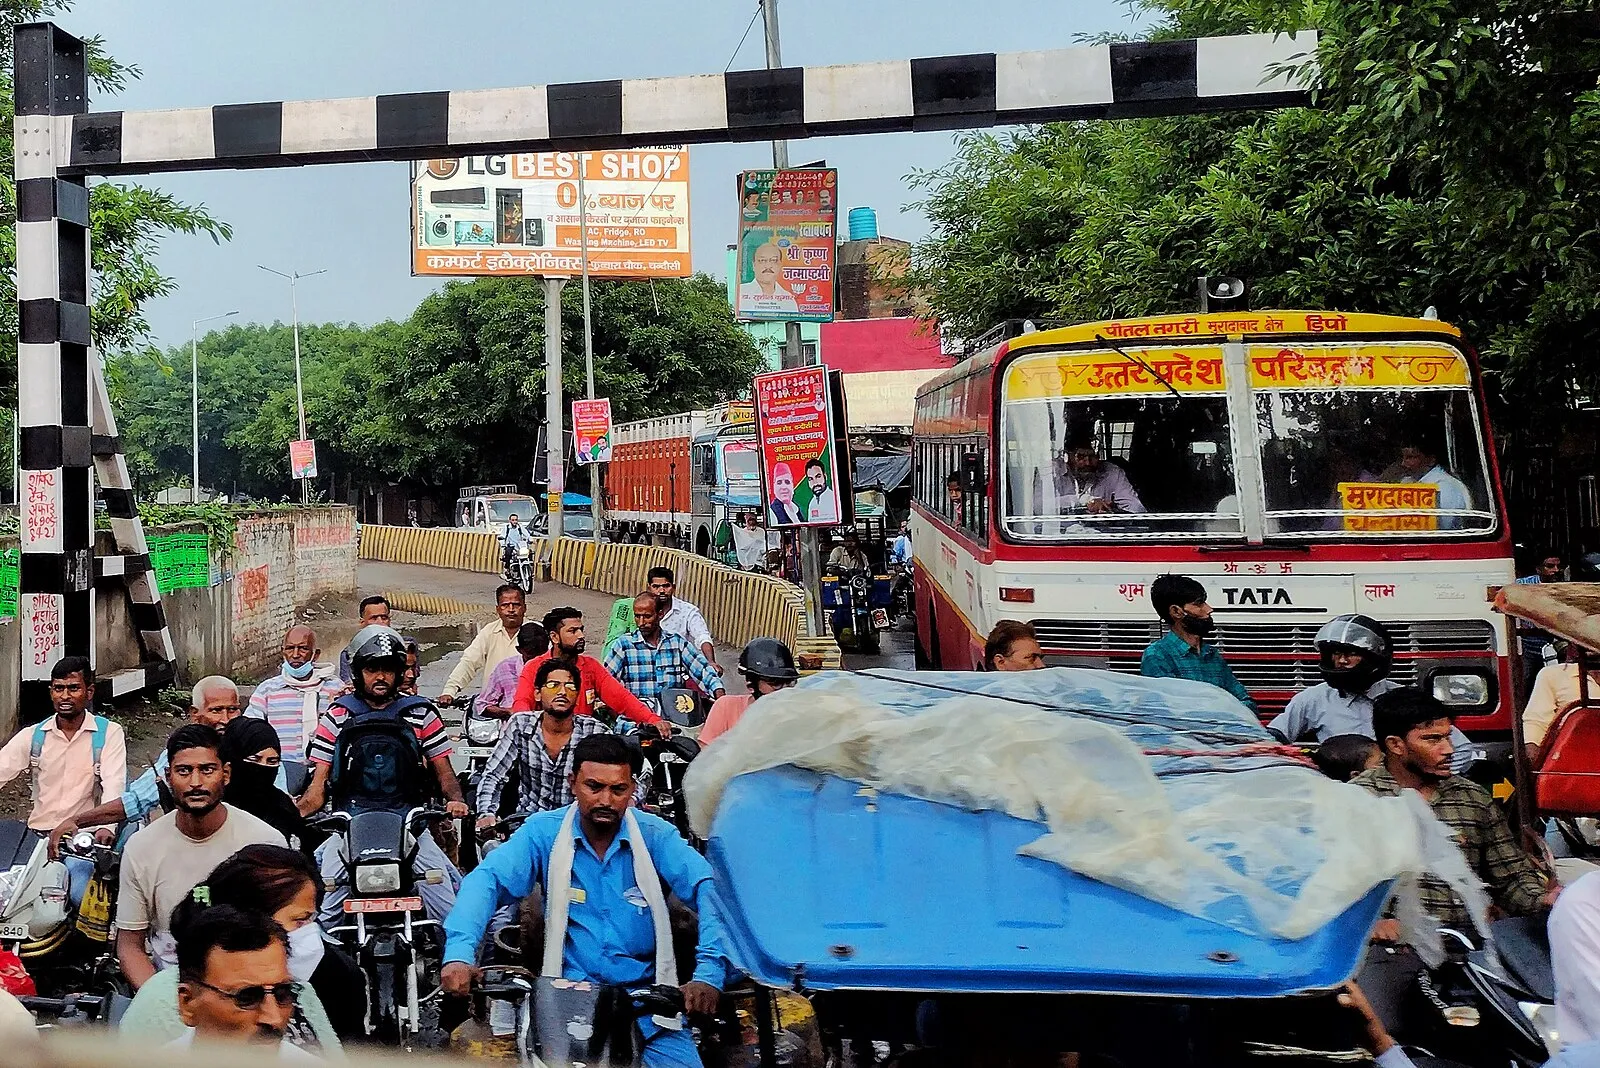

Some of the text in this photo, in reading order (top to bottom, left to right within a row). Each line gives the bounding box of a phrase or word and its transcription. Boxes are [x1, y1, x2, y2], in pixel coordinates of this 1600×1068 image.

[467, 152, 681, 179] LG BEST SHOP
[598, 193, 645, 210] ब्याज
[650, 194, 676, 210] पर
[634, 228, 645, 236] RO
[564, 237, 599, 247] Wasing
[640, 239, 655, 247] LED
[658, 239, 669, 247] TV
[787, 245, 828, 265] श्री कृष्ण
[782, 264, 830, 281] जन्माष्टमी
[1103, 323, 1149, 338] पीतल
[1153, 318, 1199, 335] नगरी
[1305, 314, 1347, 333] डिपो
[1118, 583, 1145, 602] शुभ
[1222, 587, 1292, 605] TATA
[1364, 584, 1396, 602] लाभ
